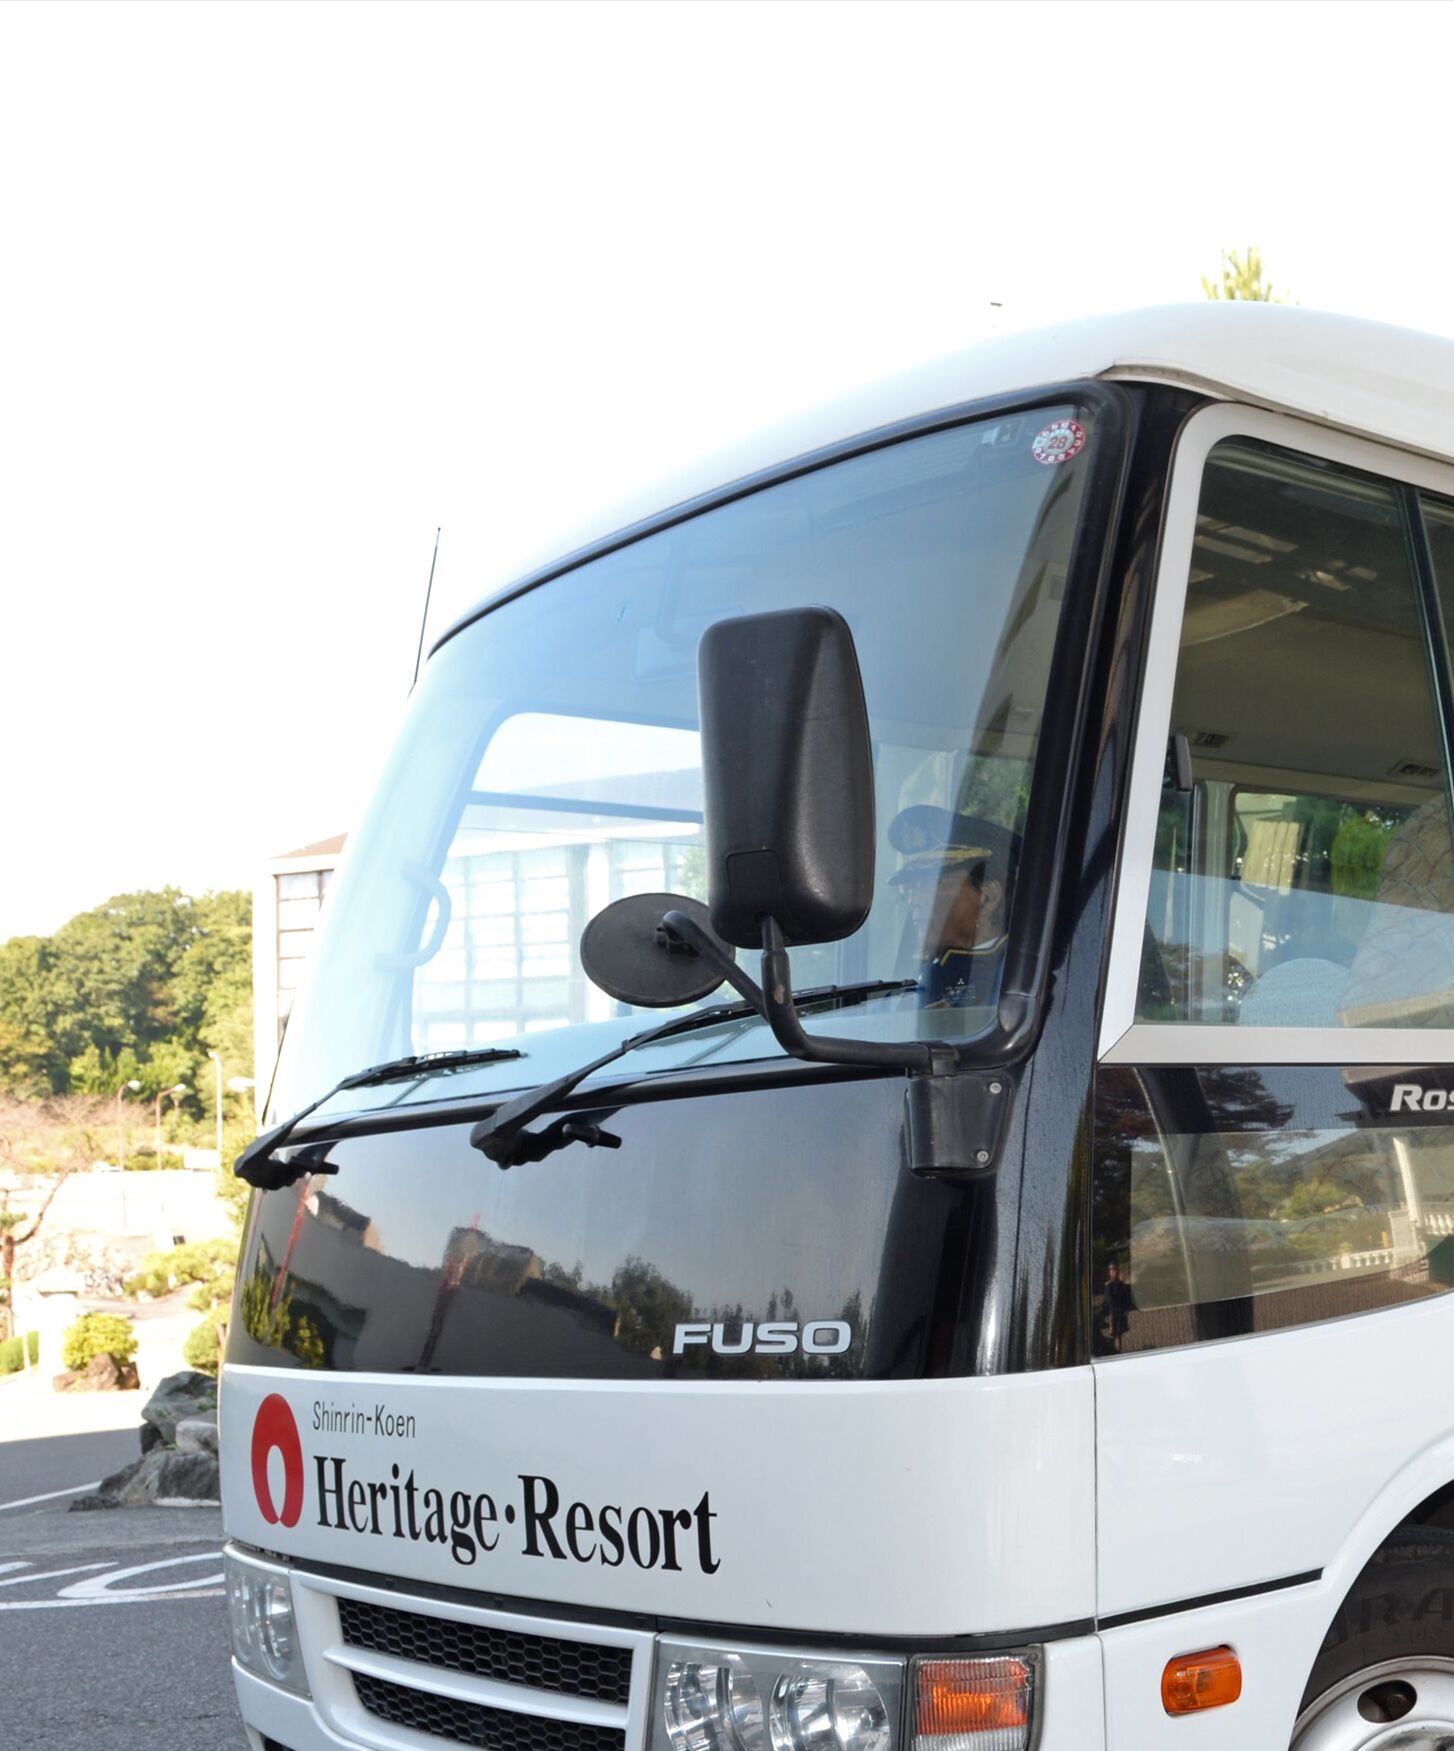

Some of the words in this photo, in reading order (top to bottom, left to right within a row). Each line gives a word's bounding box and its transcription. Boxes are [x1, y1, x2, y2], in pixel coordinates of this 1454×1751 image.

[1048, 436, 1068, 449] 28
[673, 1320, 852, 1354] FUSO
[312, 1401, 416, 1439] Shinrin-Koen
